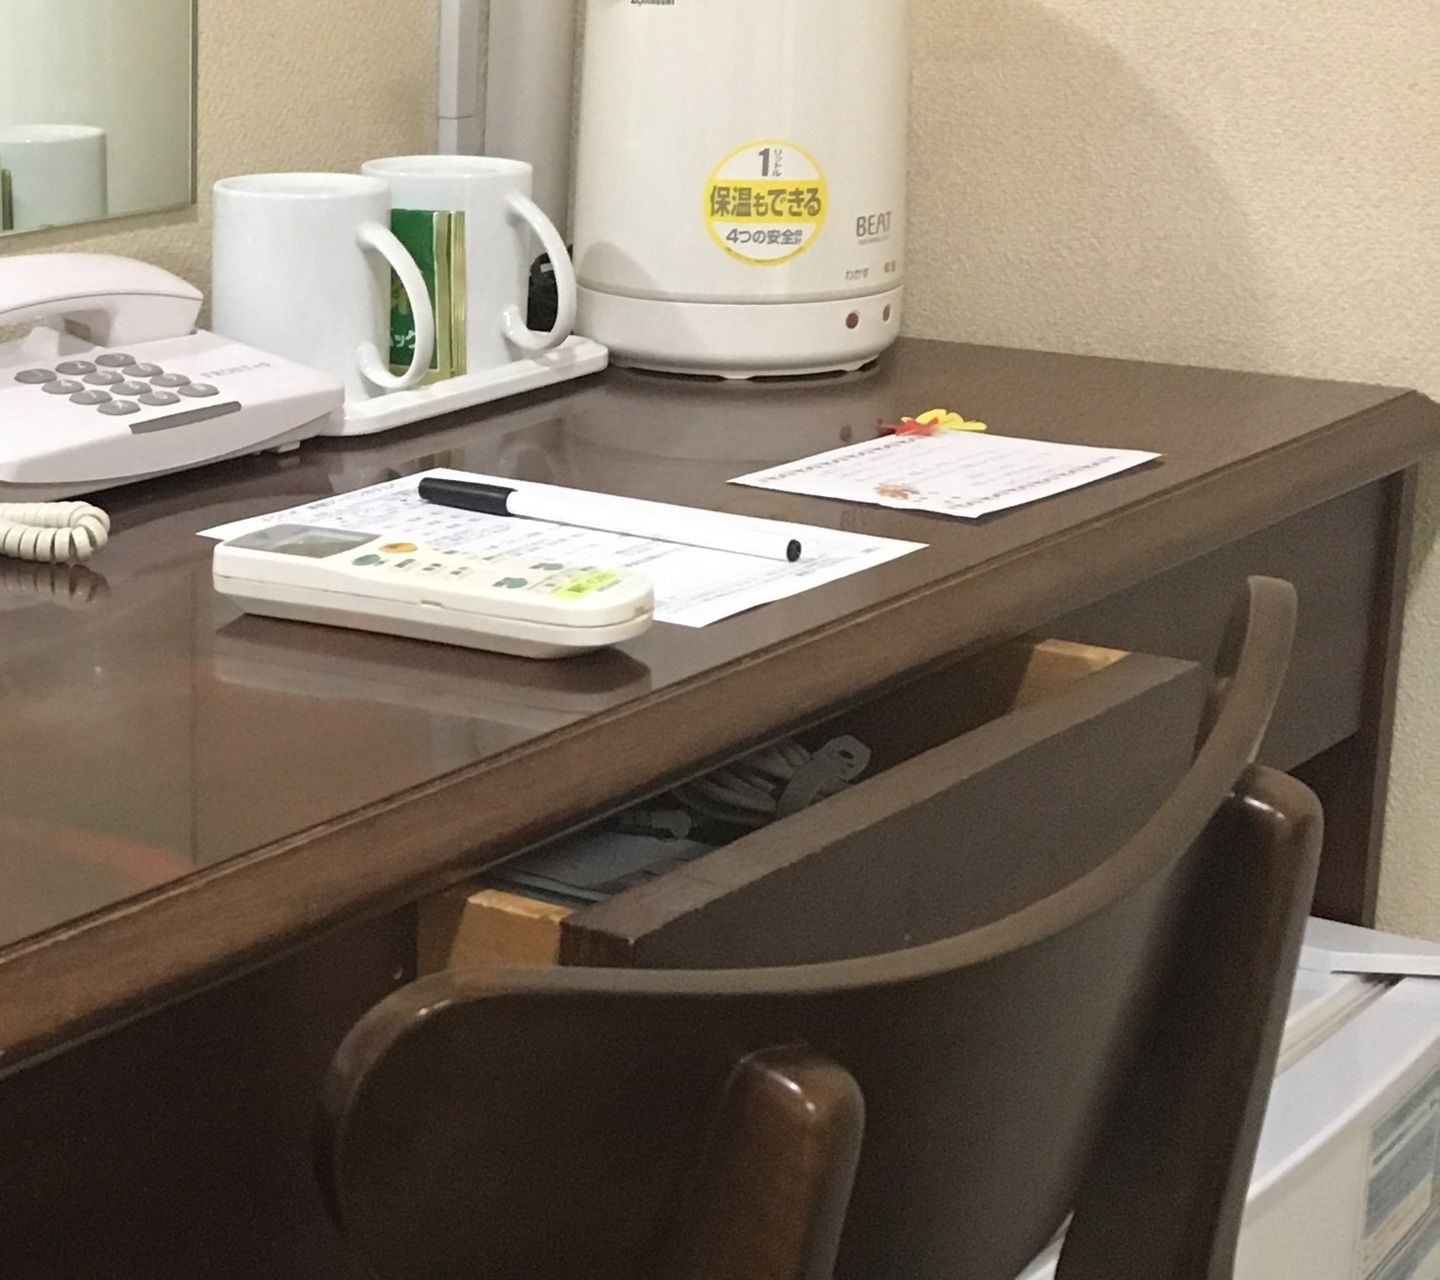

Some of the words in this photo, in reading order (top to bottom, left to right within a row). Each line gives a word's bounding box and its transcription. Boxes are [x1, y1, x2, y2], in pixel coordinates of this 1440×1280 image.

[758, 147, 771, 177] 1
[709, 185, 822, 217] 保温もできる
[855, 210, 892, 238] BEAT
